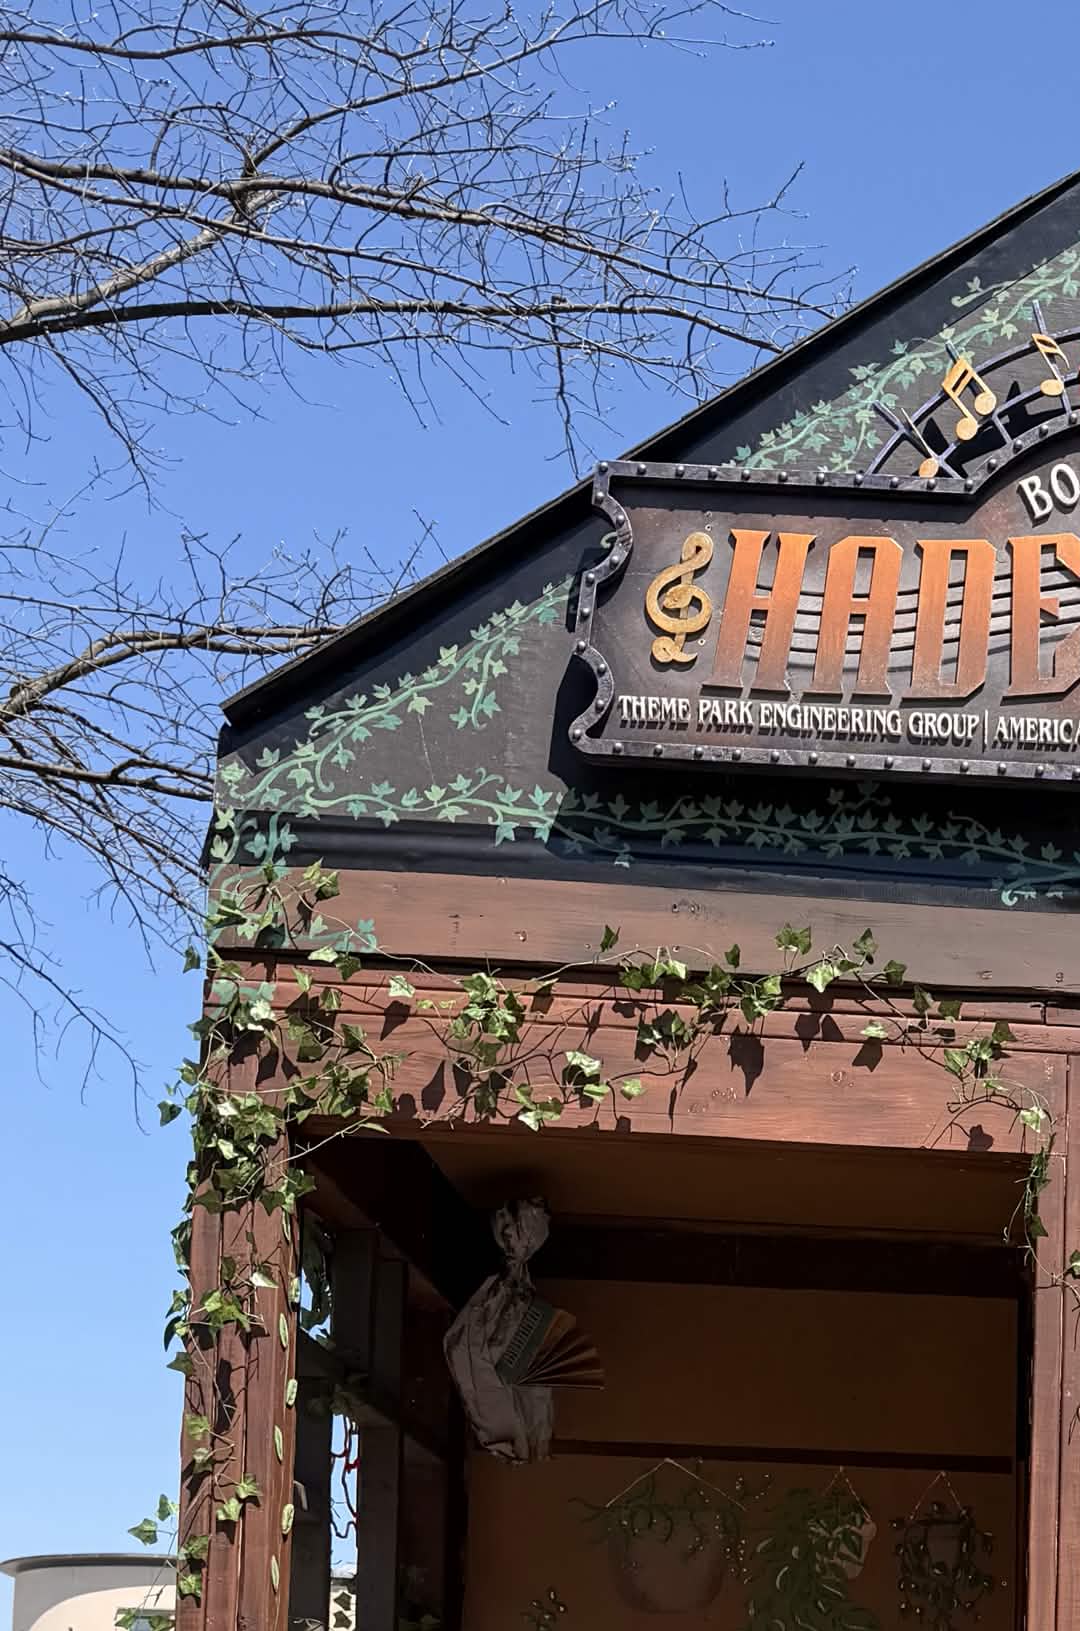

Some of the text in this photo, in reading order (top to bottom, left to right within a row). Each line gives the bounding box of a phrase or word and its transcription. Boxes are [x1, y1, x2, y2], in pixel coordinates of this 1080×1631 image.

[619, 695, 691, 721] THEME
[699, 700, 753, 726] PARK
[760, 703, 902, 735] ENGINEERING
[908, 711, 980, 738] GROUP
